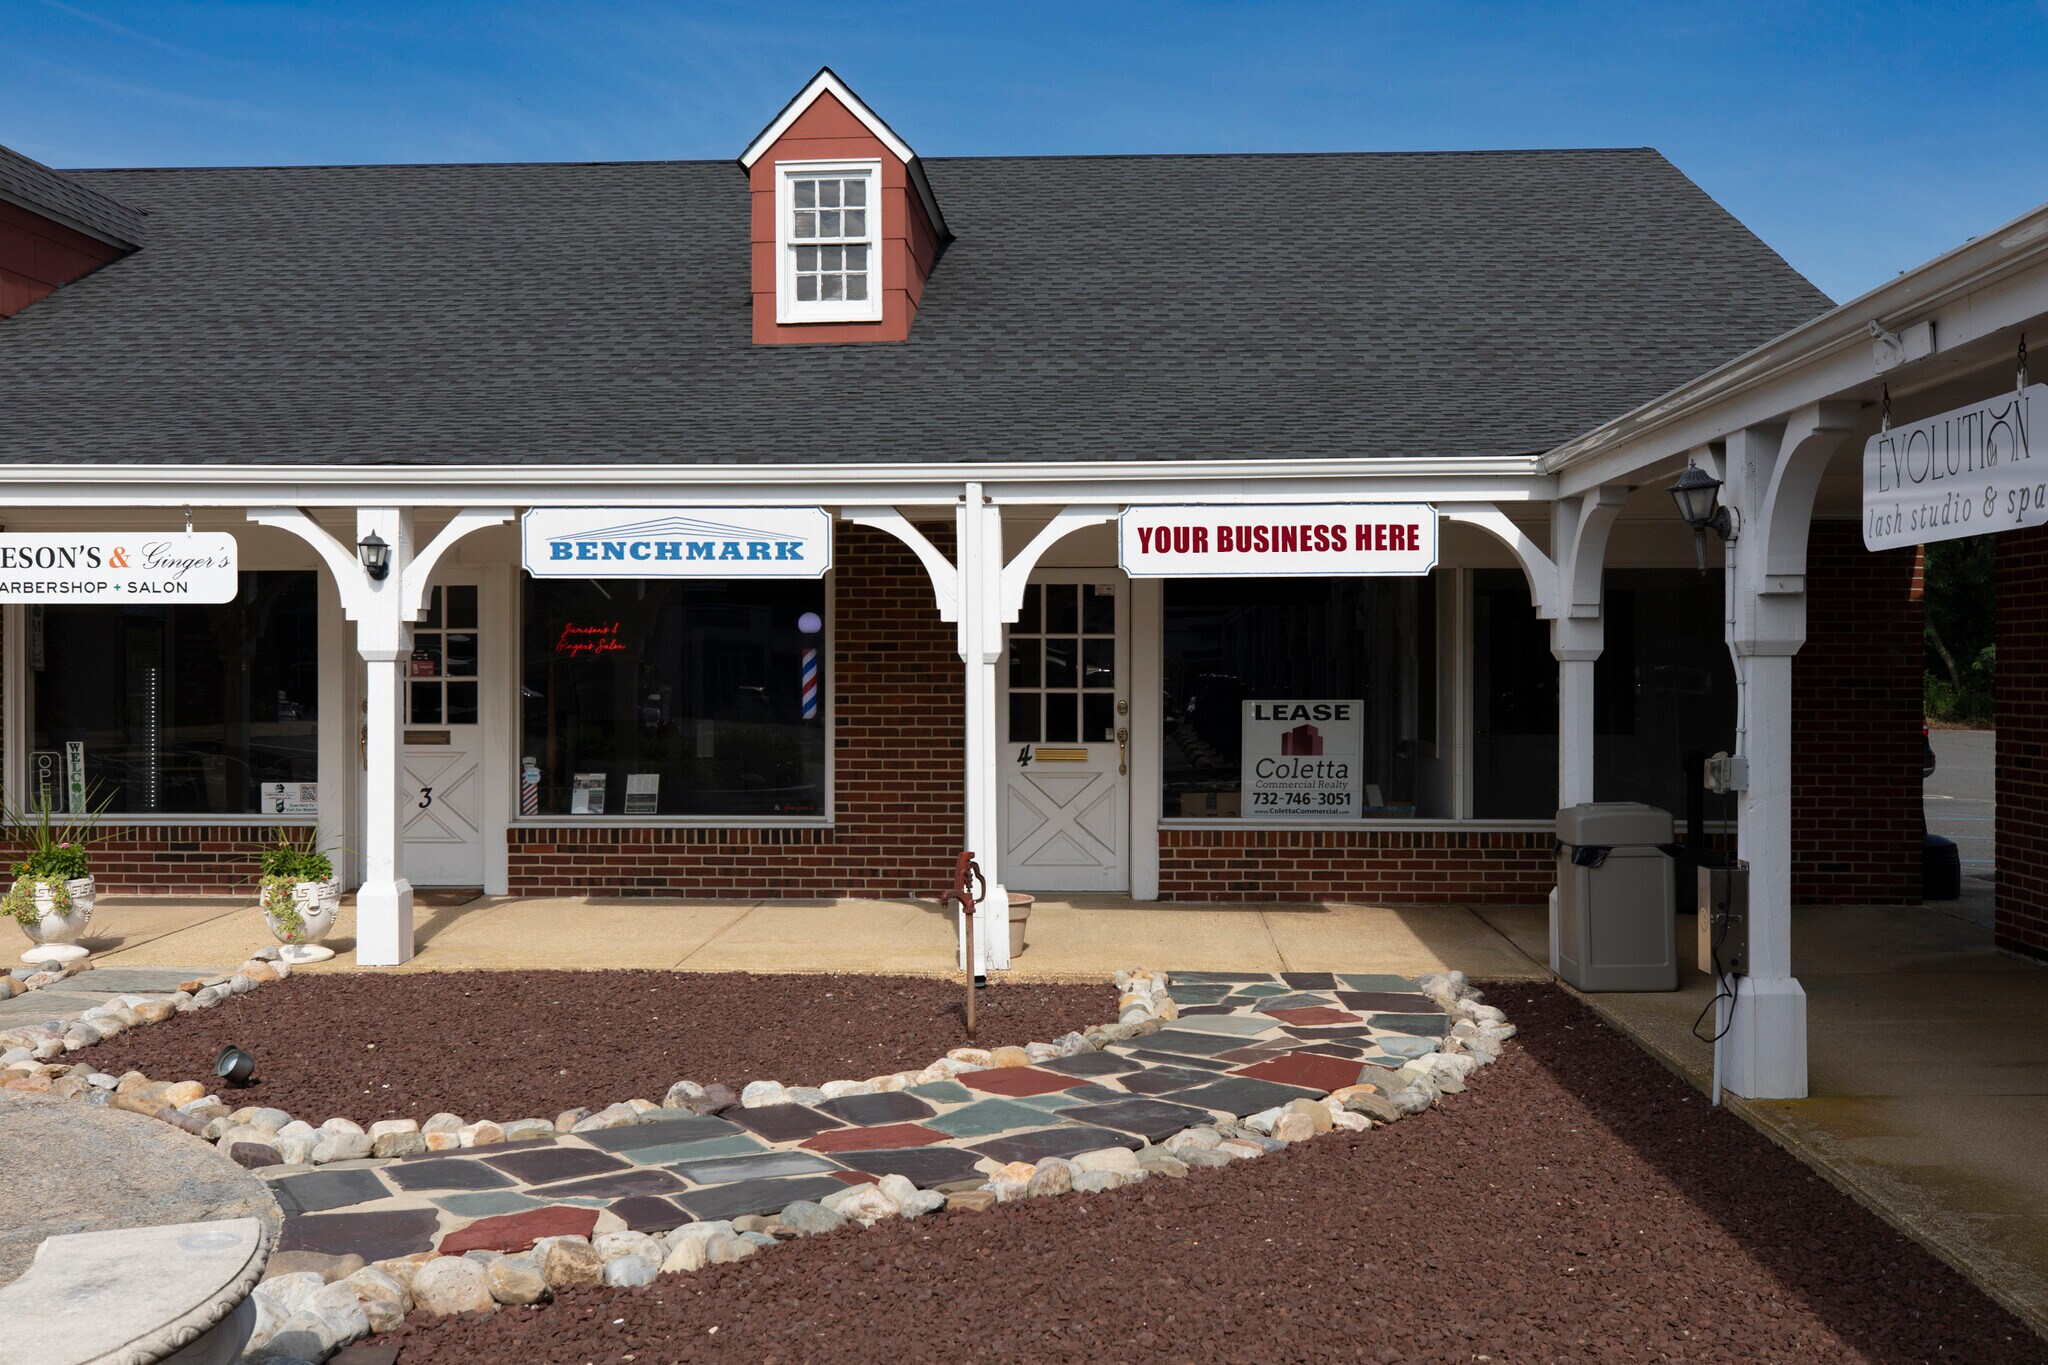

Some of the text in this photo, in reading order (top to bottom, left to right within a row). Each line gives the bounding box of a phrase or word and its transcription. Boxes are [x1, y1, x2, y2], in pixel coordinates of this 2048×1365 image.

[1879, 398, 2030, 493] EVOLUTION
[1868, 482, 2046, 539] lash studio & spa
[1137, 523, 1420, 555] YOUR BUSINESS HERE
[108, 546, 132, 569] &
[141, 541, 231, 581] Ginger's
[549, 541, 804, 561] BENCHMARK
[127, 581, 188, 594] SALON
[595, 638, 626, 654] Salon
[1255, 704, 1351, 721] LEASE
[1016, 743, 1033, 767] 4
[1255, 757, 1349, 779] Coletta
[1255, 780, 1349, 791] Commercial Realty
[418, 787, 433, 809] 3
[1252, 792, 1351, 806] 732-746-3051
[1254, 807, 1350, 815] www.ColettaCommercial.com
